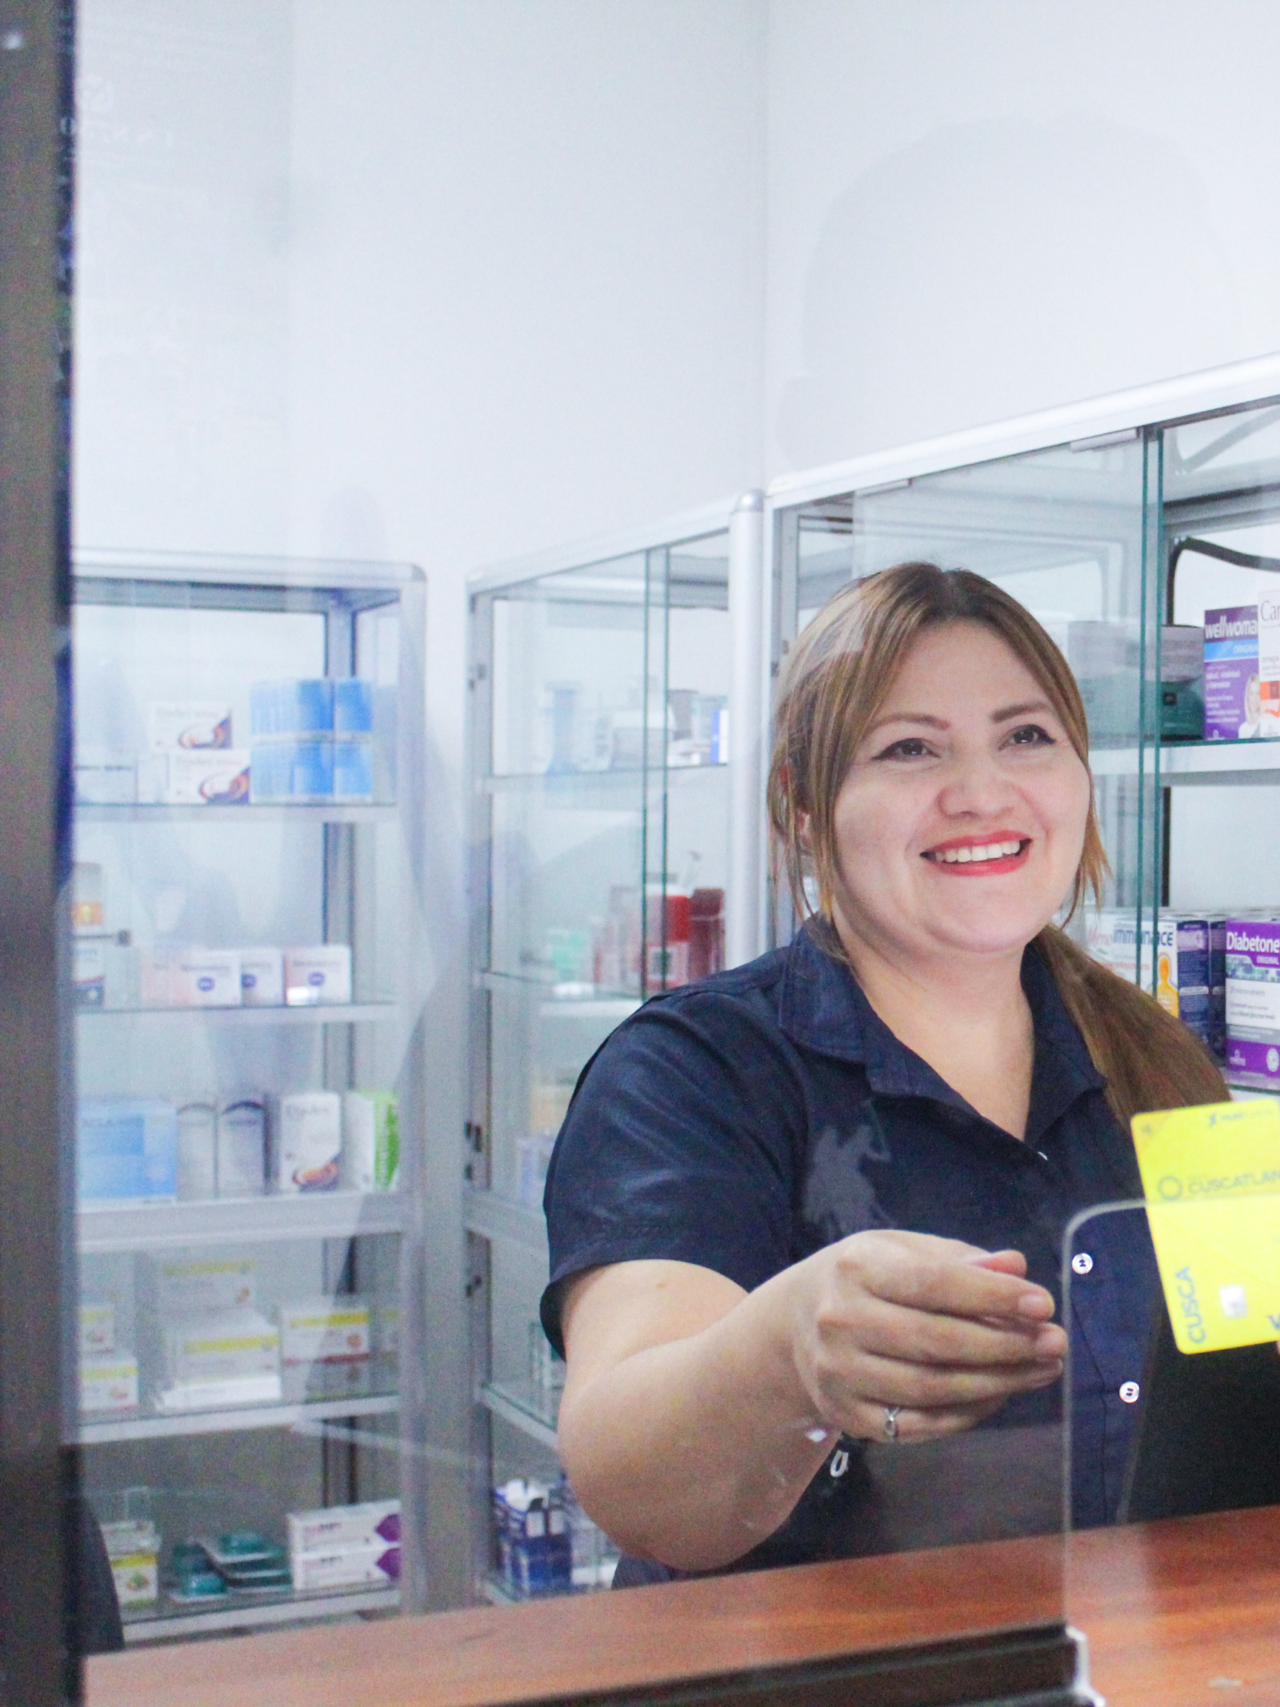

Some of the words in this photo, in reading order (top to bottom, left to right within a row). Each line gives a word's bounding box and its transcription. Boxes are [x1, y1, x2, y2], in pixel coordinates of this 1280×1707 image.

[1204, 615, 1259, 639] wellwoma
[1226, 931, 1280, 954] Diabetone
[1175, 1266, 1206, 1344] CUSCA
